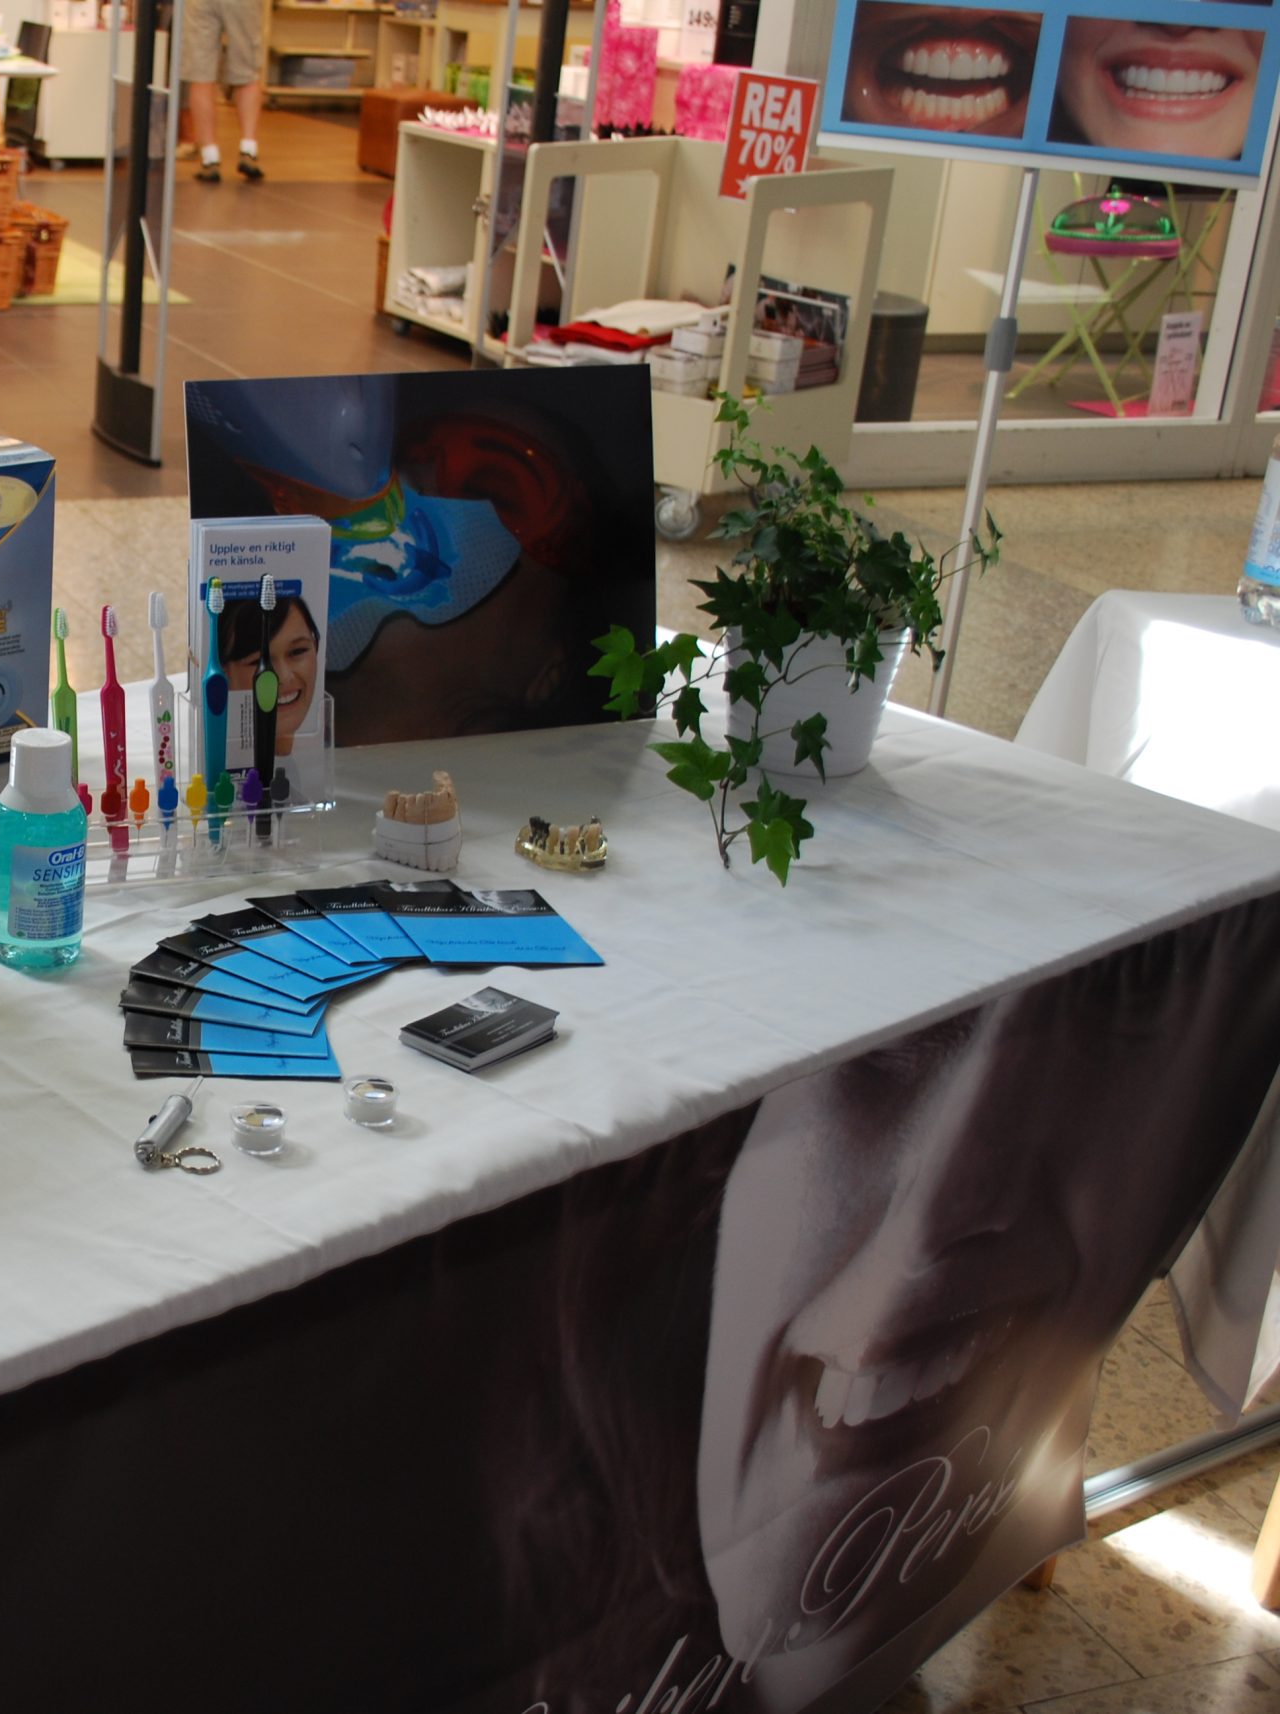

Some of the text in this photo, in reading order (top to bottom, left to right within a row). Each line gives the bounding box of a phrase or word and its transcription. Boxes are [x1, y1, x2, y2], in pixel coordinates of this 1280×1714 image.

[741, 82, 802, 134] REA
[738, 130, 796, 173] 70%
[210, 541, 296, 556] Upplev en riktigt
[209, 555, 266, 566] ren känsla.
[51, 845, 84, 865] Oral-B
